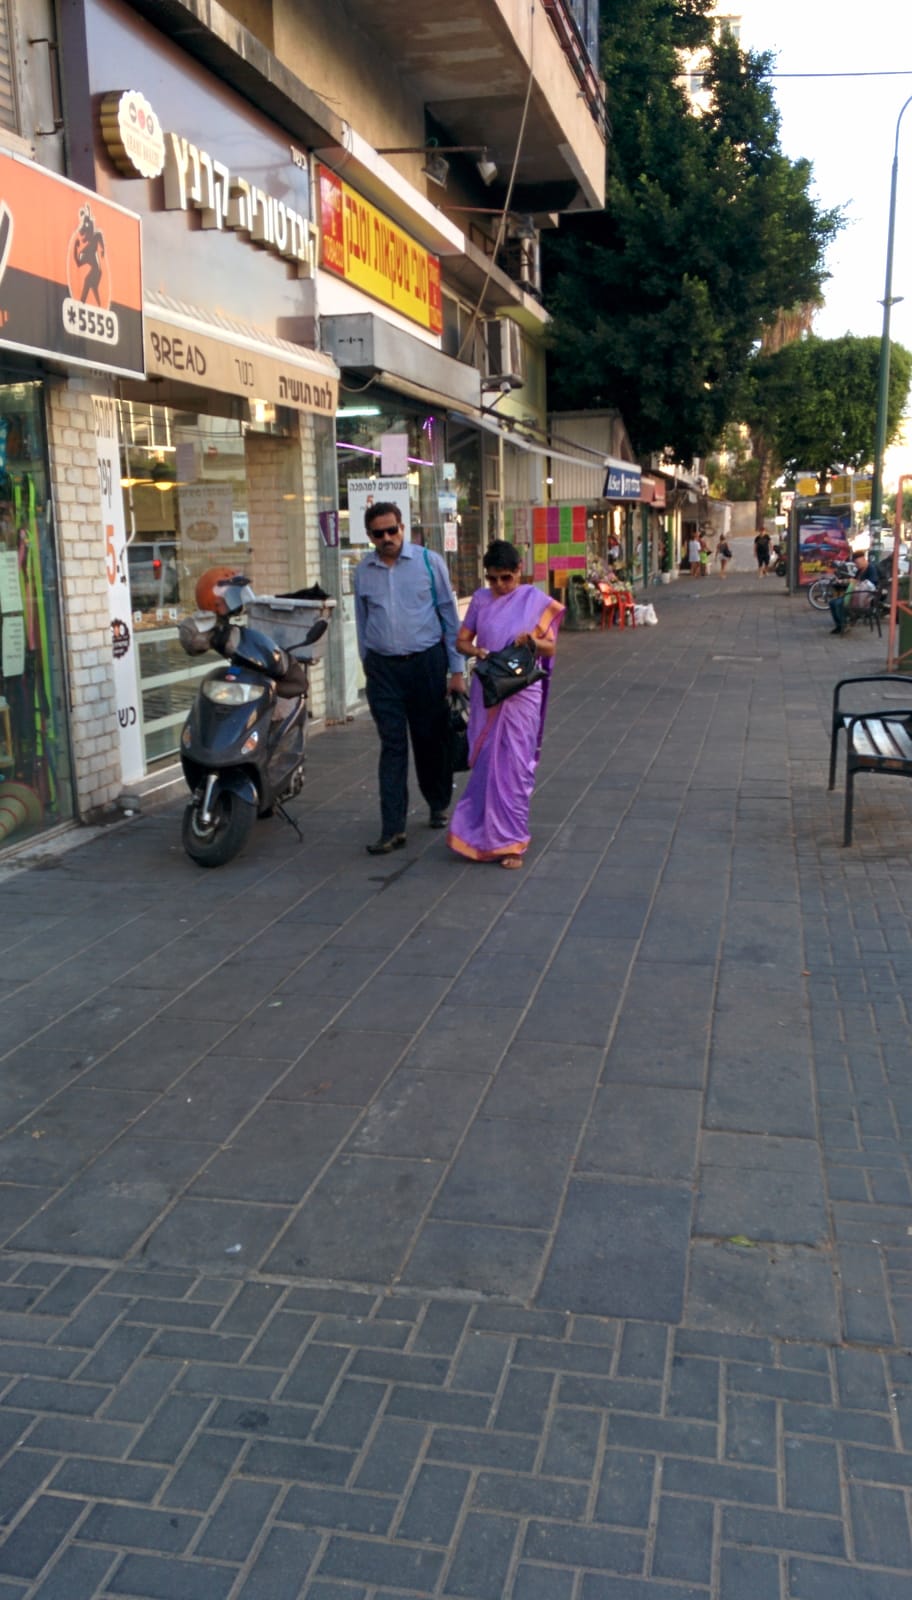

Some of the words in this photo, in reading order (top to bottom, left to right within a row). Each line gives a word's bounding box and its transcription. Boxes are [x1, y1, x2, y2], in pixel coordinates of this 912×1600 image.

[170, 132, 229, 230] קרנץ
[238, 176, 320, 279] קונדטוריה
[345, 194, 371, 273] וטבק
[373, 215, 410, 300] משקאות
[150, 331, 207, 376] BREAD
[234, 359, 255, 386] כשר
[278, 375, 312, 404] תושיה
[313, 381, 332, 410] לחם
[105, 524, 117, 586] 5
